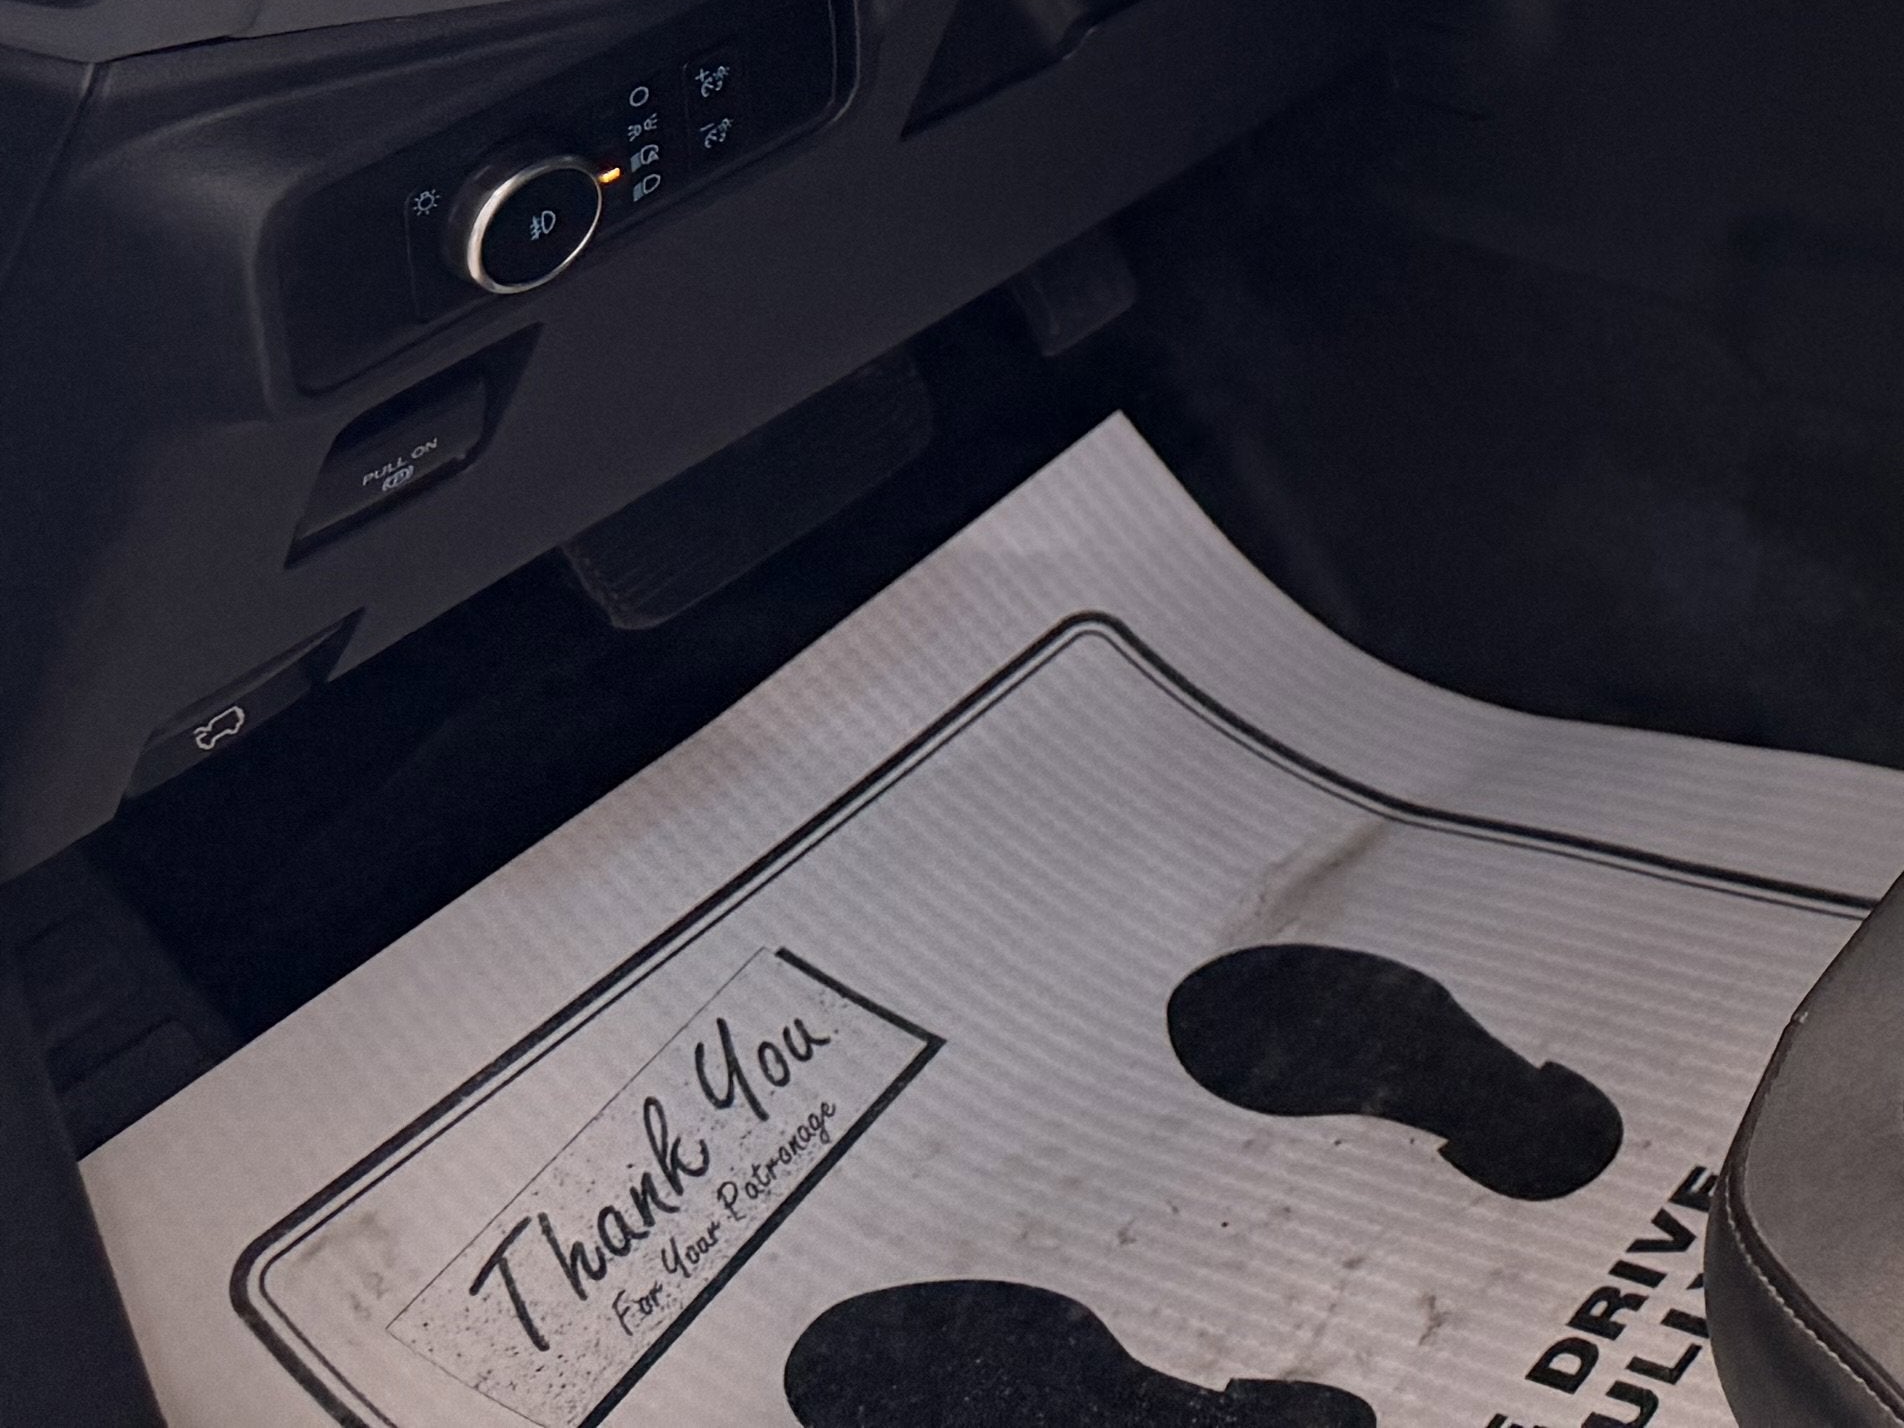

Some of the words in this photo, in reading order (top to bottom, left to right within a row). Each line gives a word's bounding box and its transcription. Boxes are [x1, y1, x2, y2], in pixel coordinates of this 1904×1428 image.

[362, 456, 409, 486] PULL
[411, 437, 438, 459] ON
[470, 1096, 710, 1351] Thank
[694, 1017, 832, 1122] You
[612, 1280, 664, 1337] For
[660, 1220, 721, 1279] Your
[716, 1101, 837, 1222] Patronage
[1525, 1165, 1719, 1395] DRIVE
